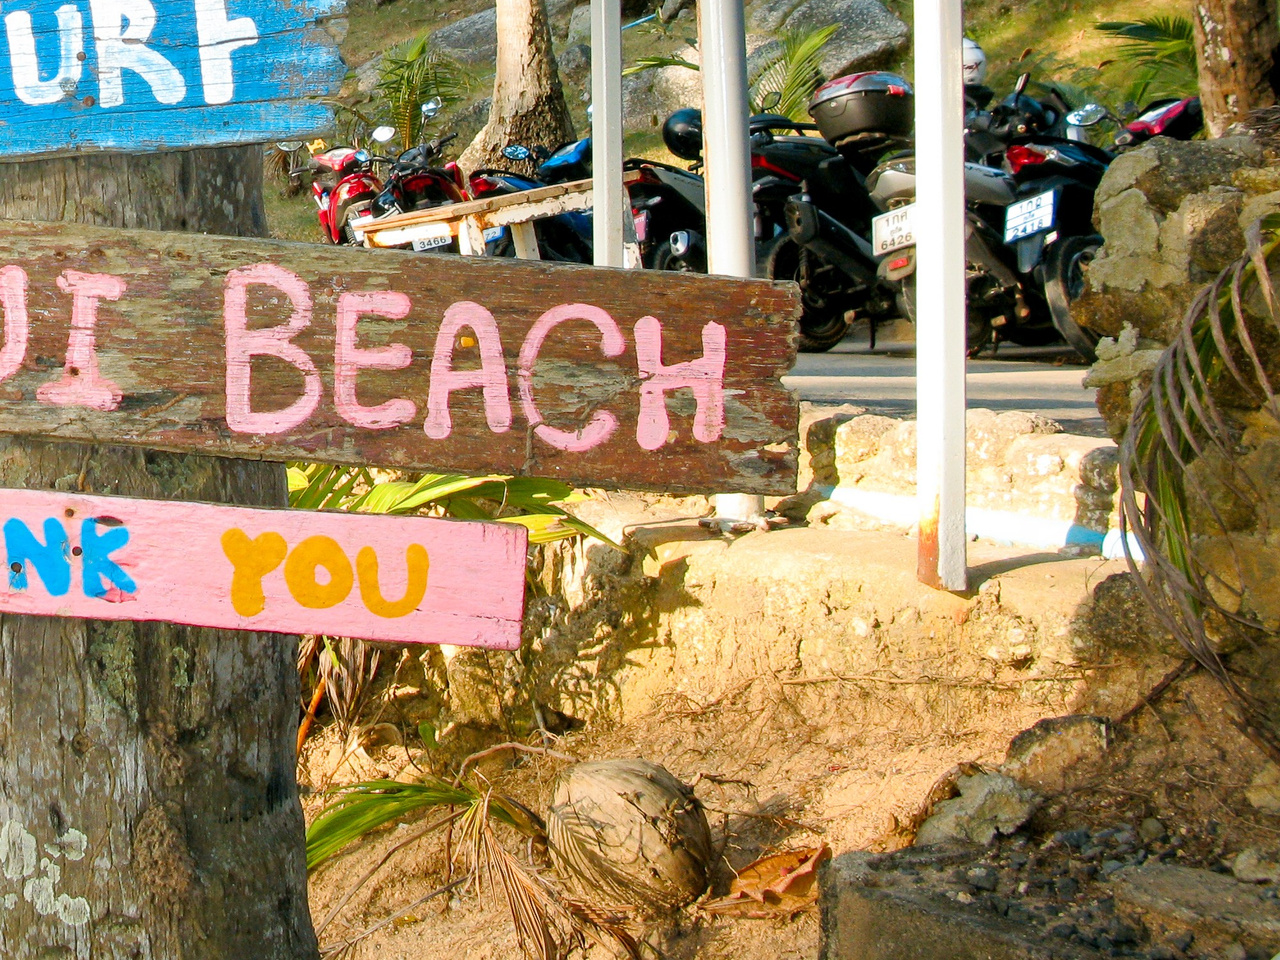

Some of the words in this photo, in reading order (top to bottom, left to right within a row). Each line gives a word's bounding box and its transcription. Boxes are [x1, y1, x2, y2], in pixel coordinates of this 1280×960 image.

[419, 237, 447, 249] 3466
[881, 232, 912, 250] 6426
[223, 263, 727, 451] BEACH
[220, 527, 429, 617] YOU
